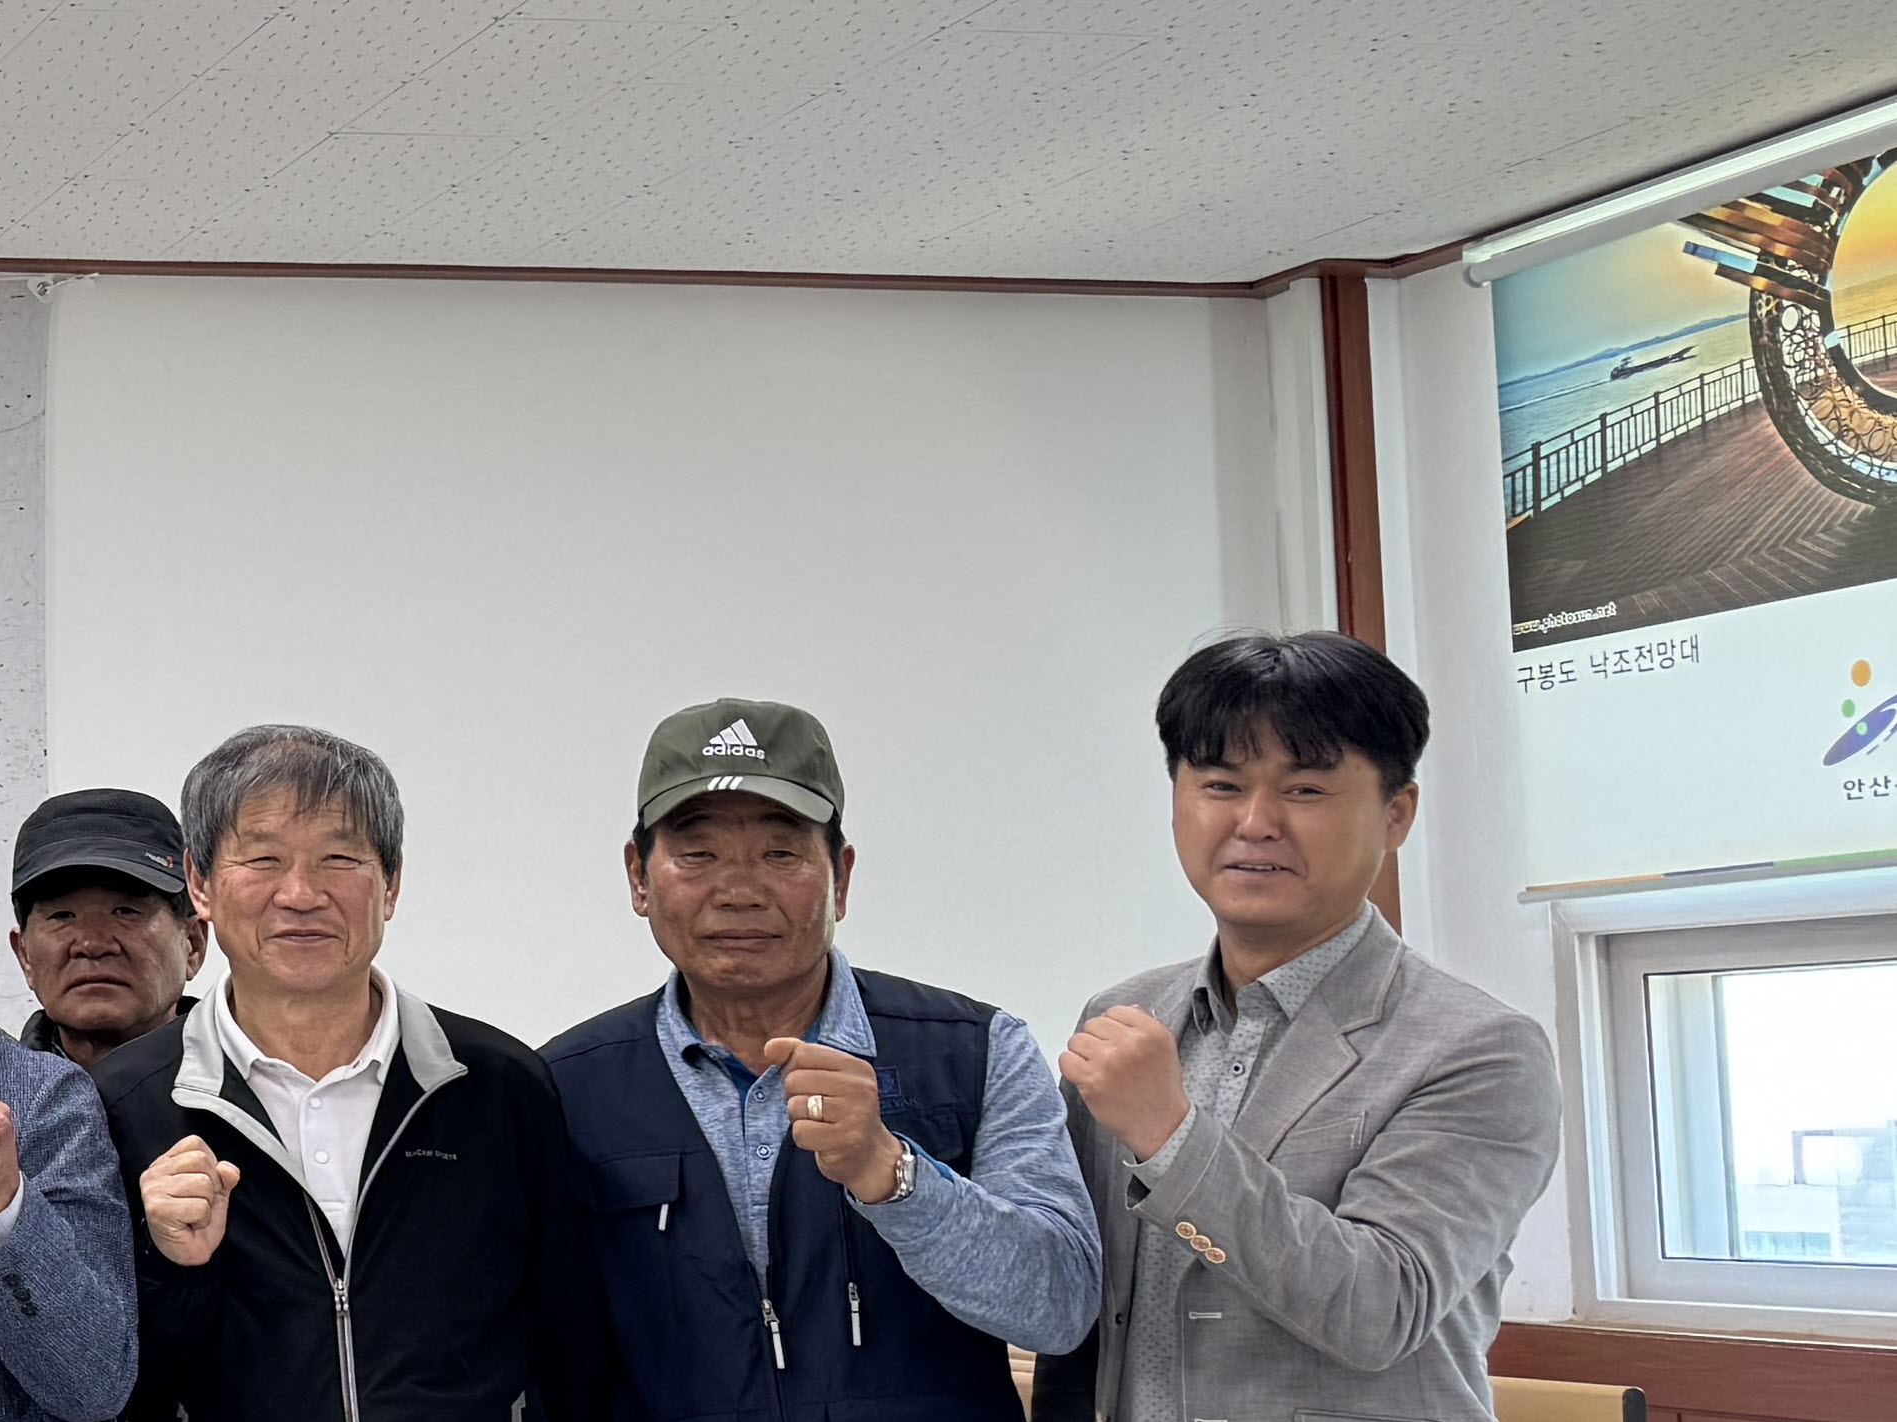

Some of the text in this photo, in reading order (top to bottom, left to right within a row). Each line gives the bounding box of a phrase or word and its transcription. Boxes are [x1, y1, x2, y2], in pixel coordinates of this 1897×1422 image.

[1517, 634, 1700, 694] 구봉도 낙조전망대
[702, 744, 765, 760] adidas
[1843, 775, 1897, 801] 안산
